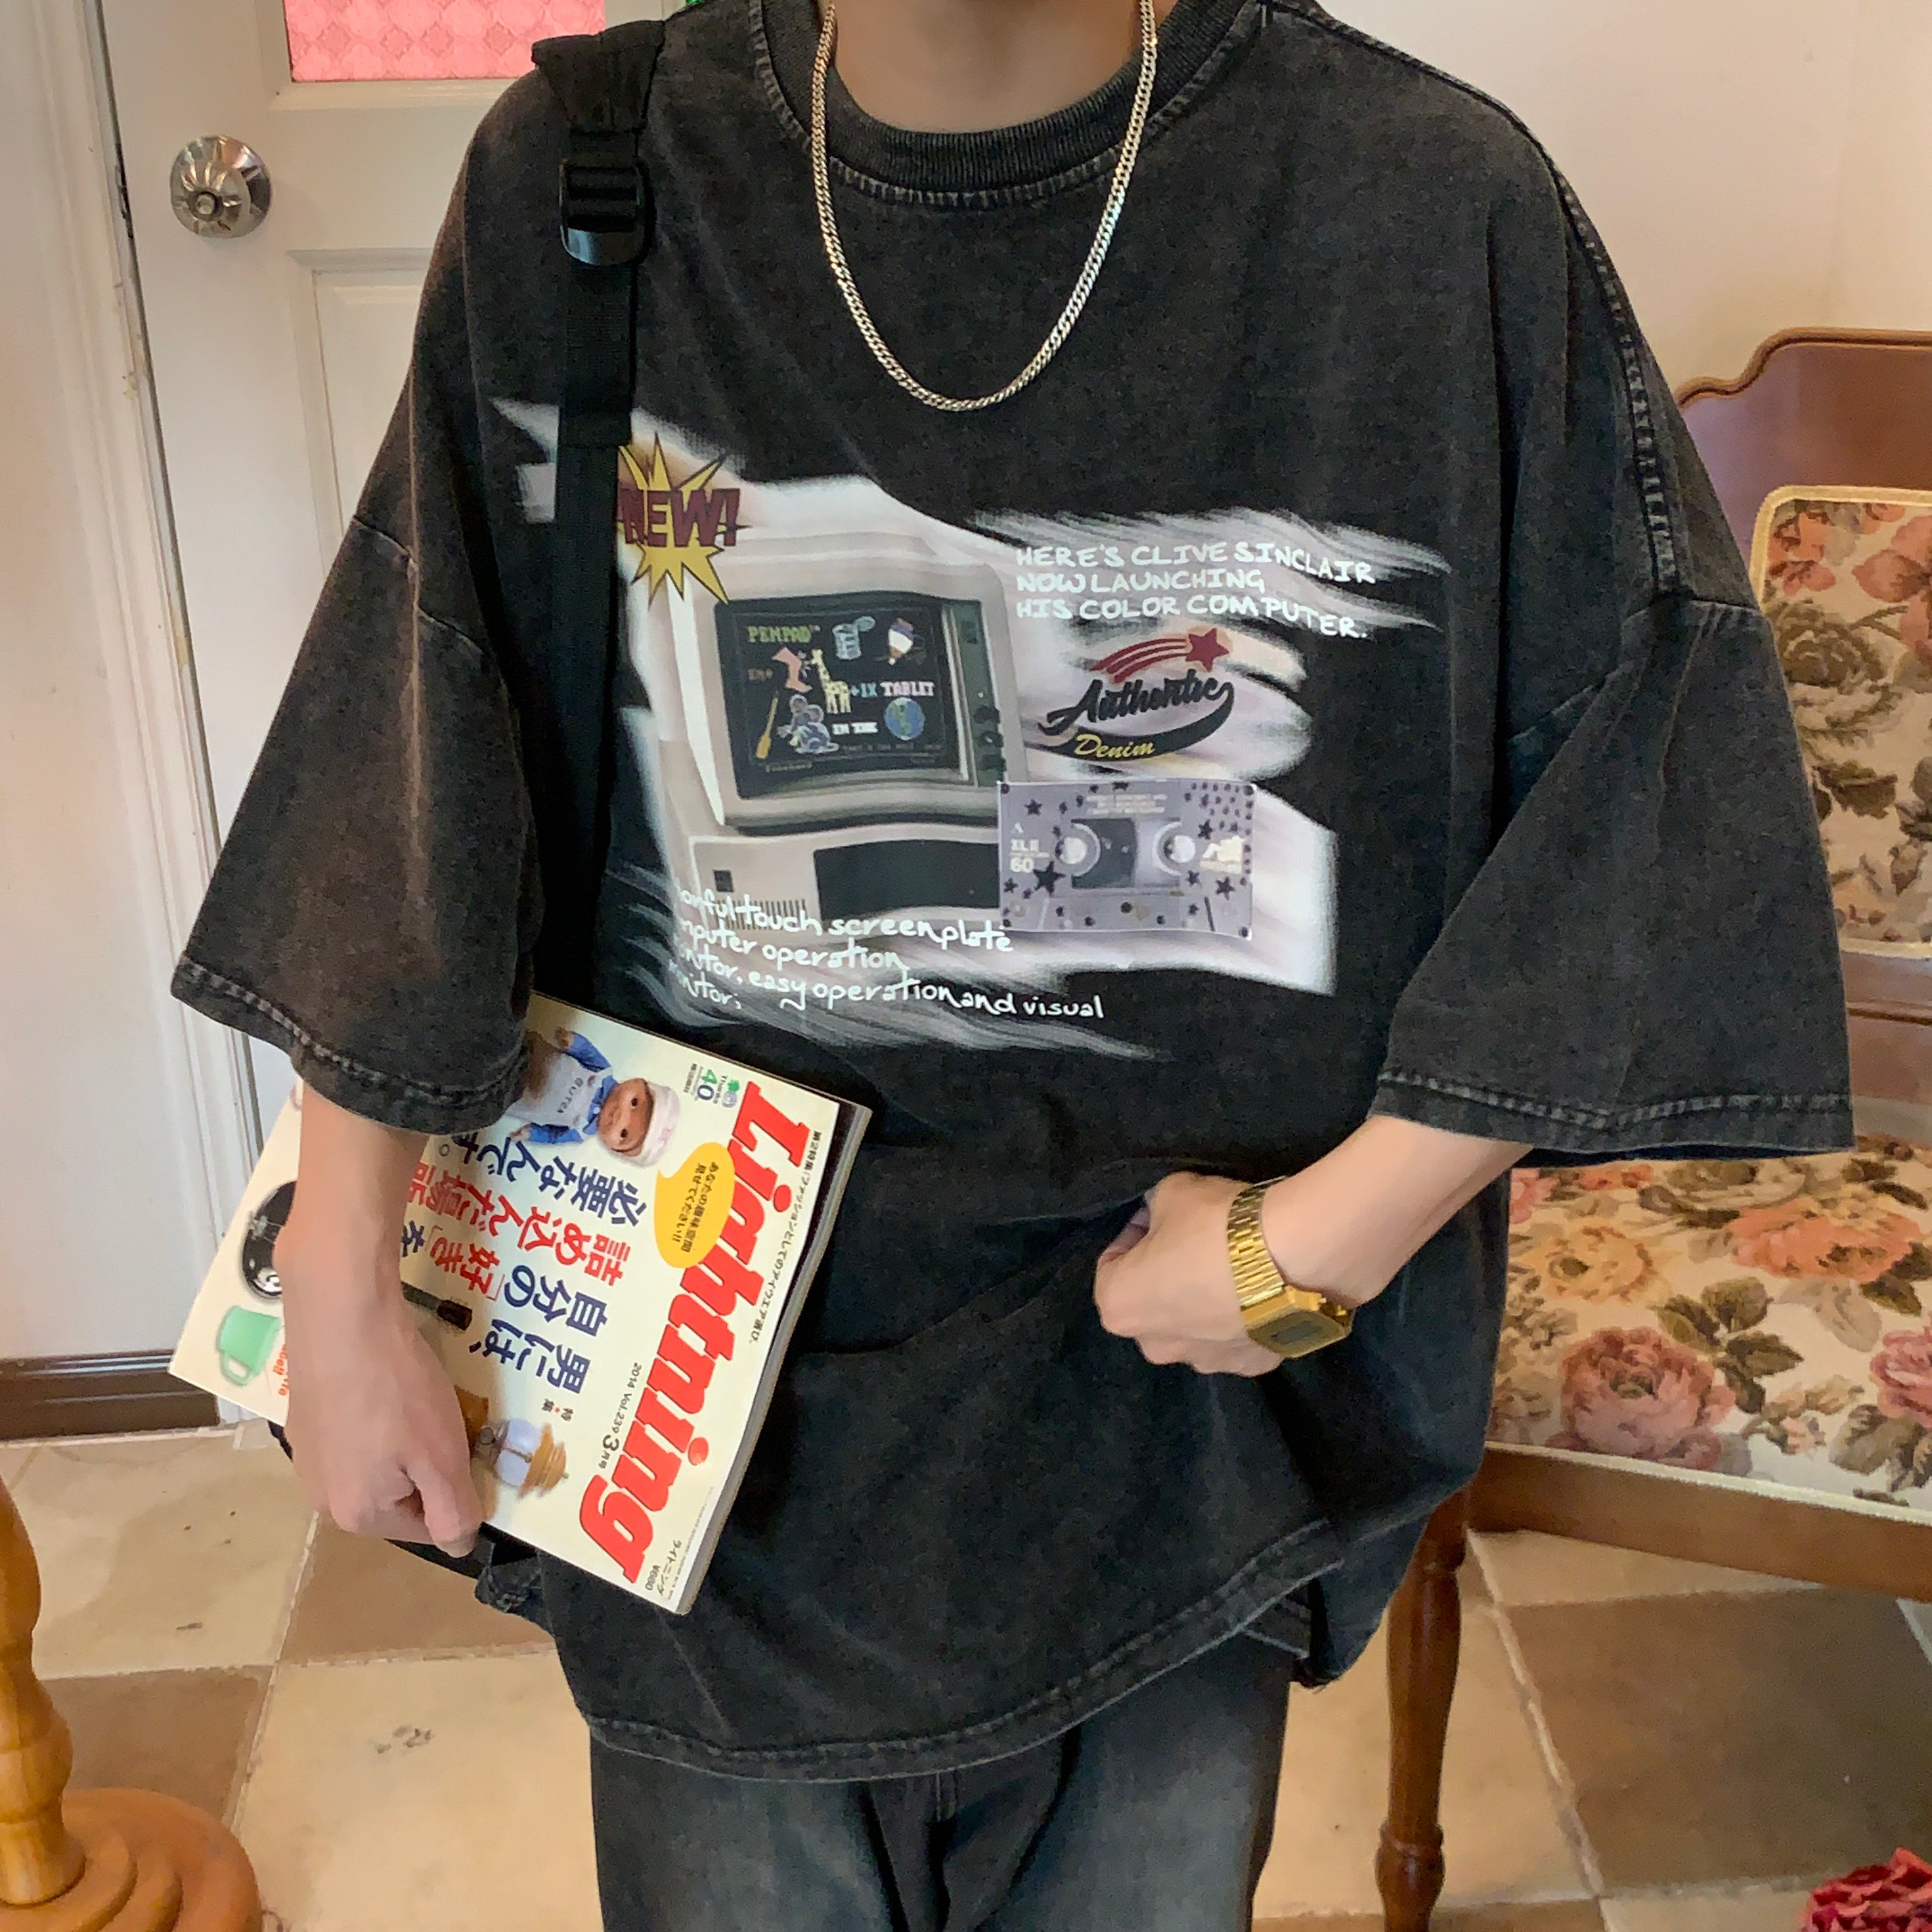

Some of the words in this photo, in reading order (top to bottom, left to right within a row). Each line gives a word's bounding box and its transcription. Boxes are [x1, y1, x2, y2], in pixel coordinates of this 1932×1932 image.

[618, 487, 741, 547] NEW!
[1017, 544, 1125, 567] HERE'S
[1131, 542, 1228, 565] CLIVE
[1234, 541, 1376, 584] SINCLAIR
[1017, 573, 1086, 593] NOW
[1090, 569, 1265, 594] LAUNCHING
[1017, 598, 1073, 619] HIS
[1080, 596, 1181, 619] COLOR
[1187, 594, 1367, 638] COMPUTER.
[1074, 734, 1156, 758] Denim
[735, 894, 822, 936] touch
[762, 937, 911, 971] operation
[749, 971, 807, 1011] easy
[1022, 994, 1105, 1019] visual
[695, 1068, 720, 1101] 40
[468, 1318, 591, 1394] 男には、
[626, 1361, 642, 1389] 2014
